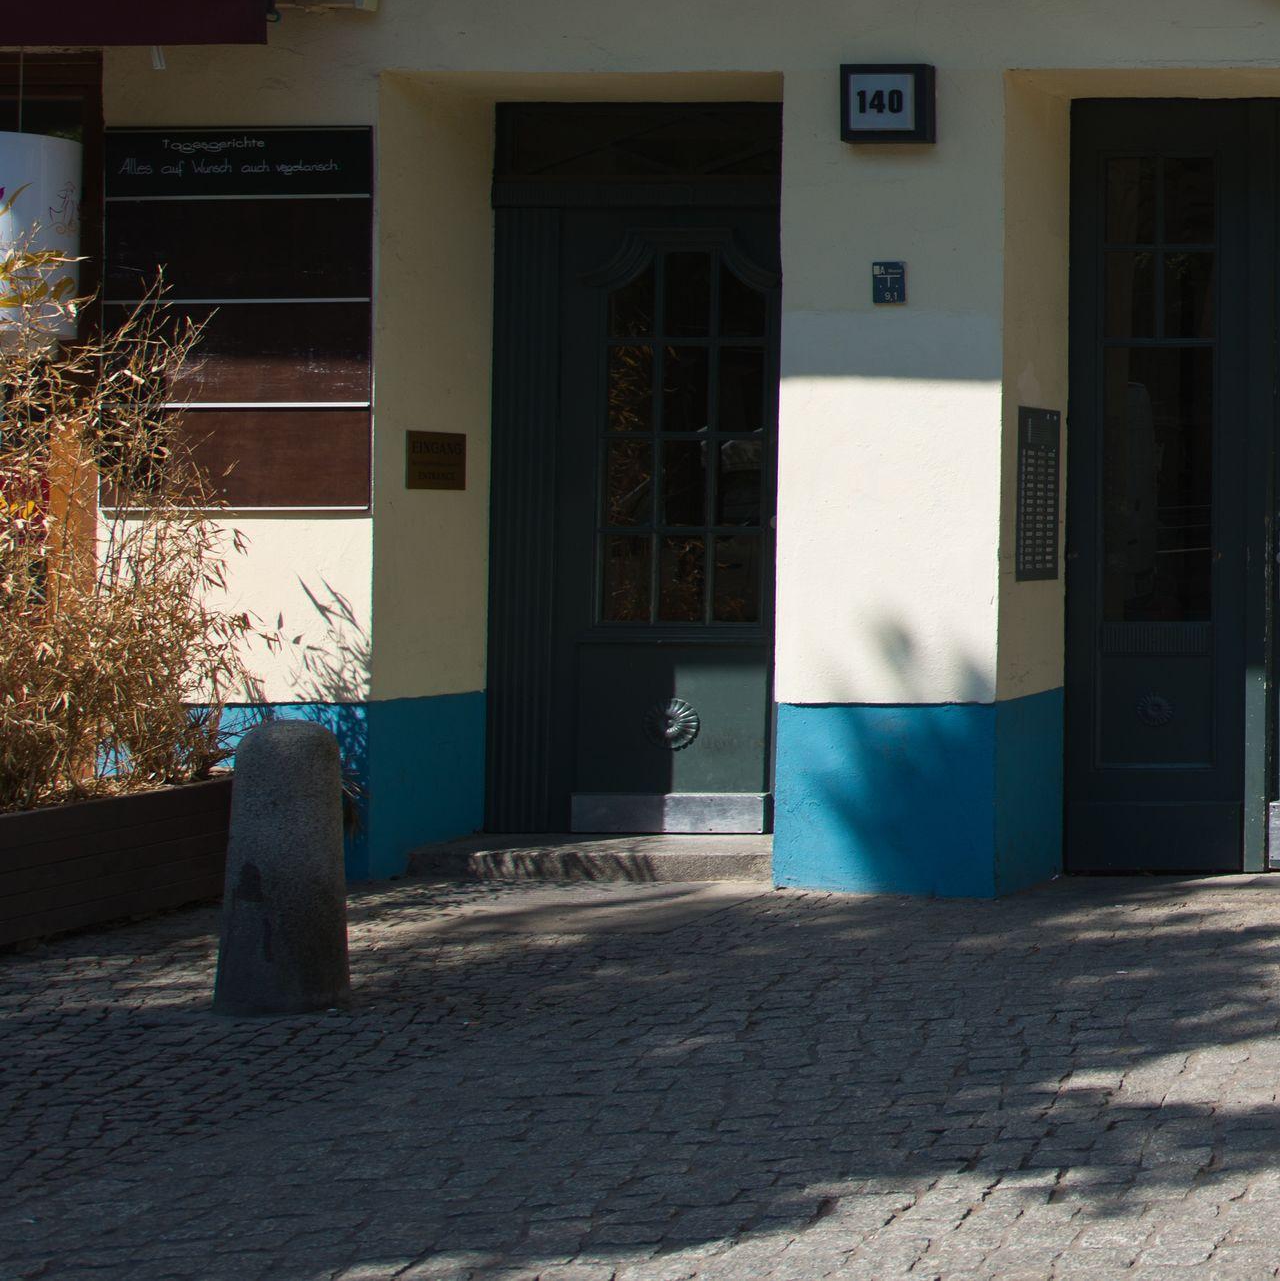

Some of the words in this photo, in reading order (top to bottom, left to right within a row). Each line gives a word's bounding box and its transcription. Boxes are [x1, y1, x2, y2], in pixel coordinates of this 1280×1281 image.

[857, 89, 903, 114] 140
[161, 136, 266, 154] Tagesgerichte
[118, 159, 153, 175] Alles
[160, 160, 185, 177] auf
[191, 159, 232, 174] Wunsch
[240, 161, 270, 173] auch
[412, 439, 464, 455] EINGANG
